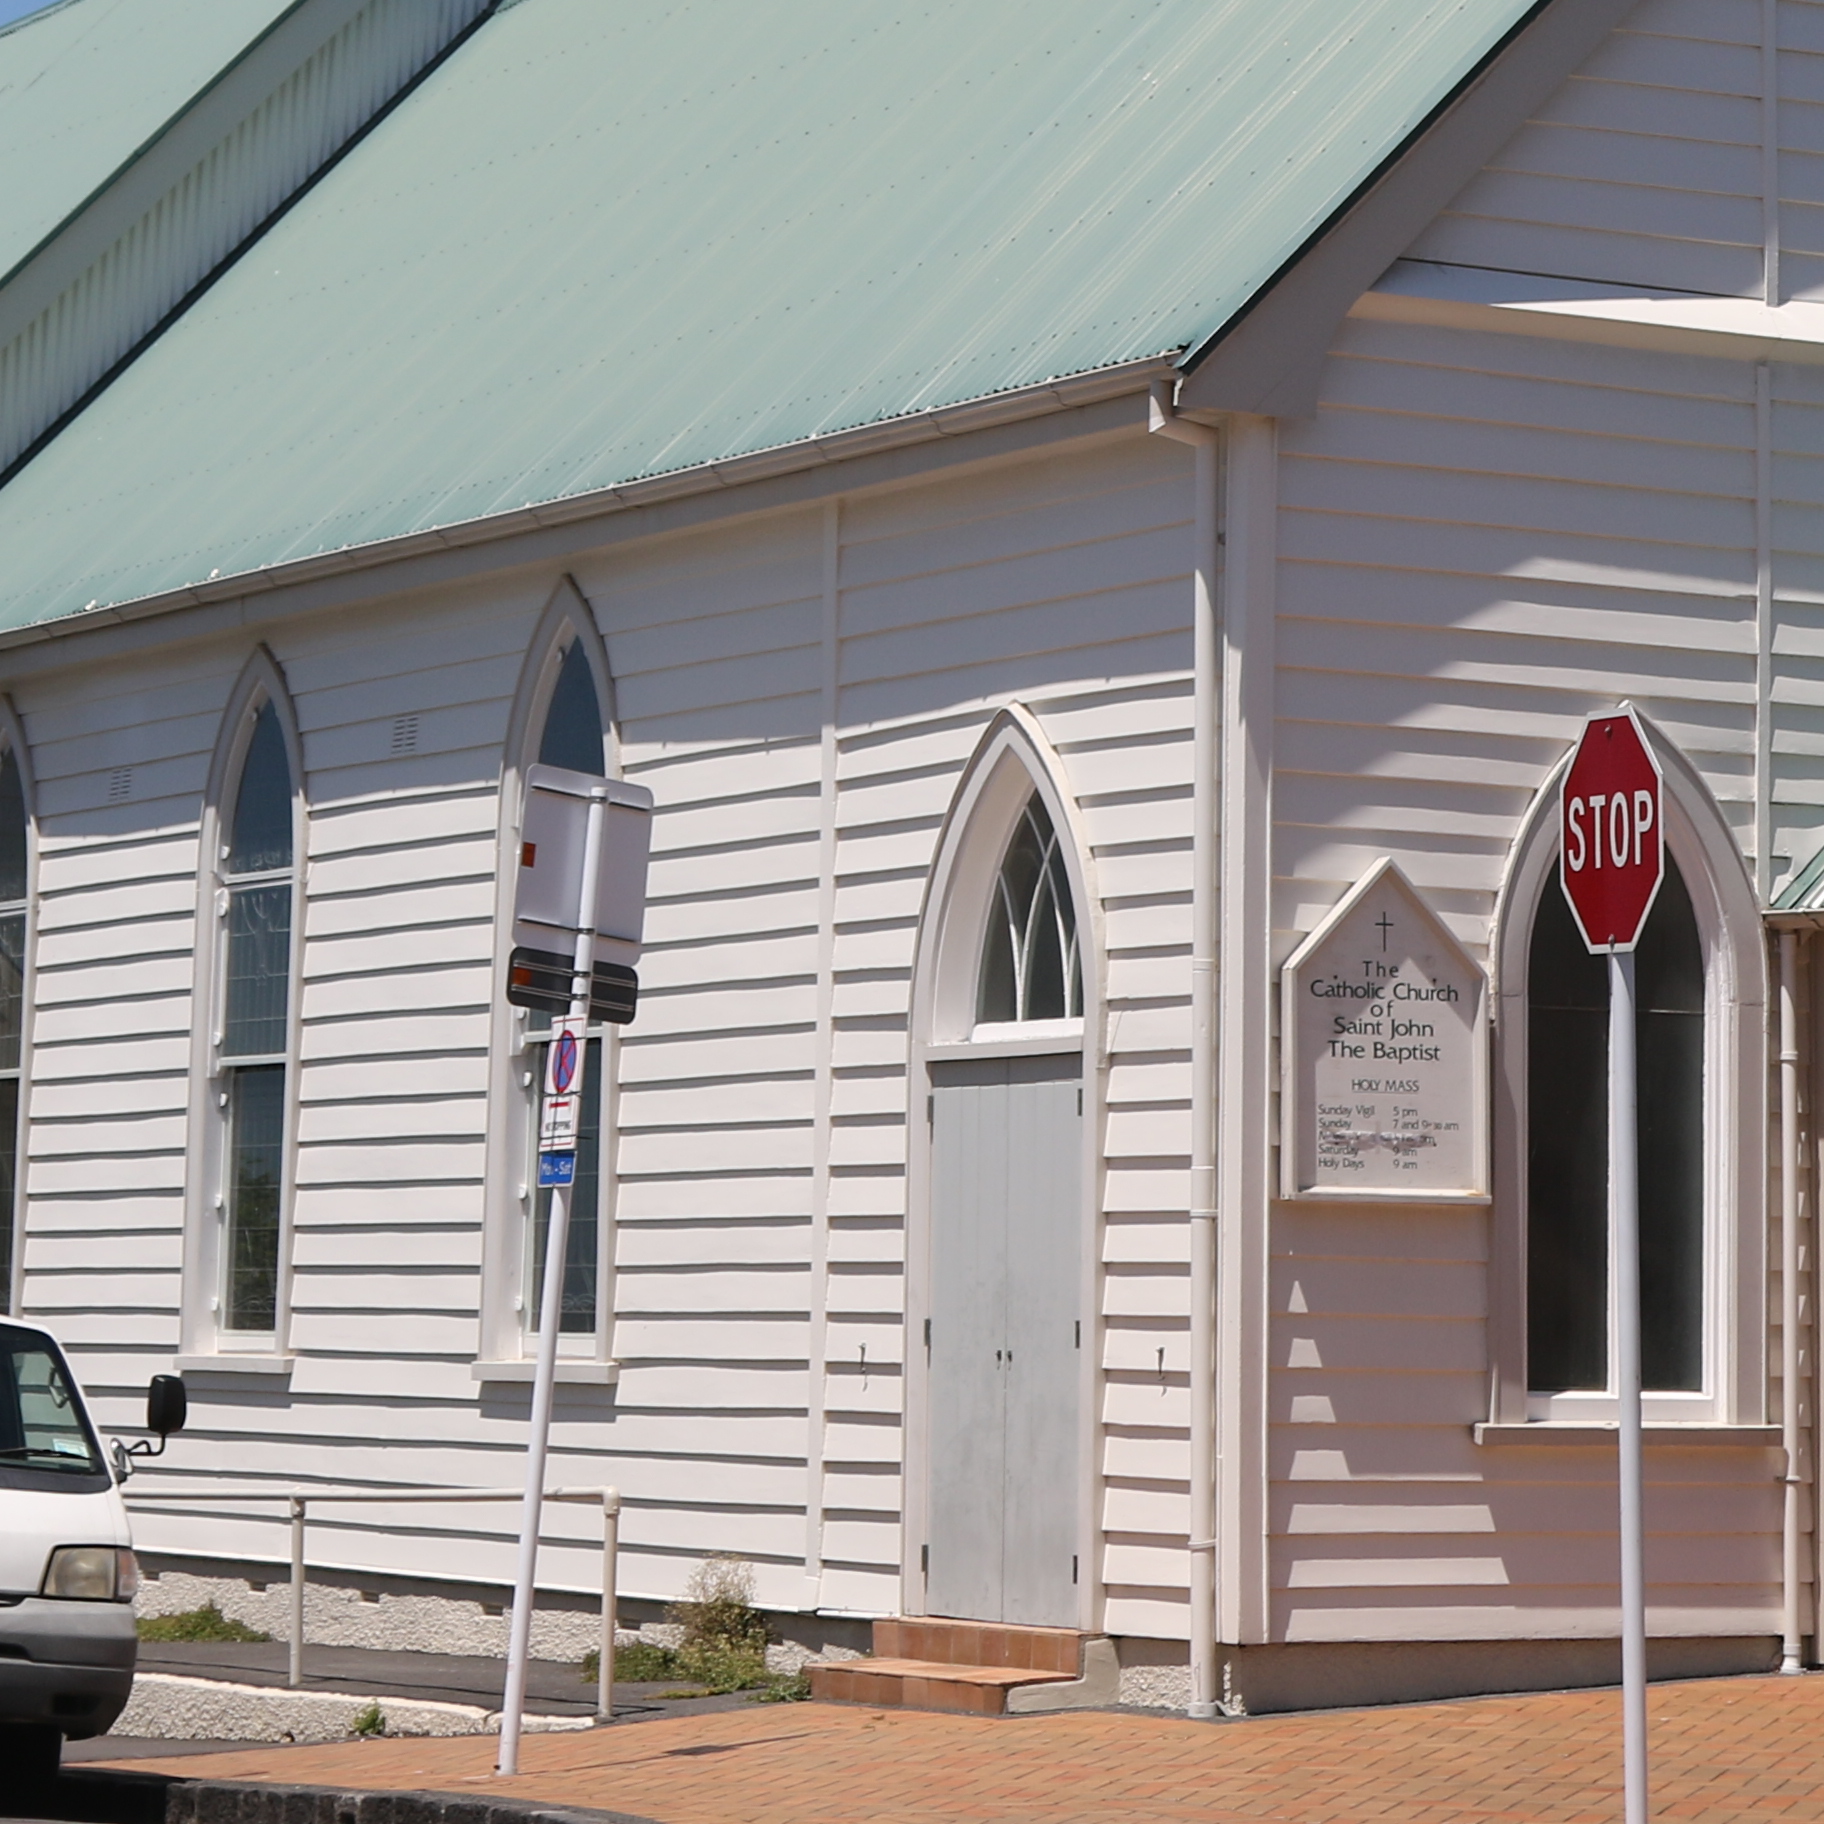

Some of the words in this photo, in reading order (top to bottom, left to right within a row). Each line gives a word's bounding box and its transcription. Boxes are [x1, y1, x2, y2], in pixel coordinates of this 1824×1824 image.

[1567, 789, 1654, 873] STOP
[1362, 960, 1399, 977] The
[1310, 979, 1386, 1000] Catholic
[1393, 982, 1459, 1003] Church
[1370, 1000, 1394, 1018] of
[1333, 1016, 1383, 1036] Saint
[1389, 1019, 1434, 1041] John
[1328, 1040, 1365, 1059] The
[1373, 1041, 1441, 1064] Baptist
[1351, 1078, 1381, 1092] HOLY
[1385, 1079, 1420, 1093] MASS
[1318, 1104, 1353, 1118] Sunday
[1355, 1105, 1376, 1118] Vigil
[1392, 1106, 1400, 1117] 5
[1402, 1108, 1418, 1118] pm
[1318, 1117, 1352, 1129] Sunday
[1392, 1119, 1399, 1130] 7
[1401, 1119, 1419, 1130] and
[1443, 1122, 1459, 1131] am
[1318, 1144, 1359, 1158] Saturday
[1392, 1146, 1400, 1156] 9
[1402, 1148, 1417, 1157] am
[1318, 1158, 1340, 1170] Holy
[1342, 1159, 1365, 1171] Days
[1392, 1159, 1400, 1169] 9
[1402, 1161, 1418, 1170] am
